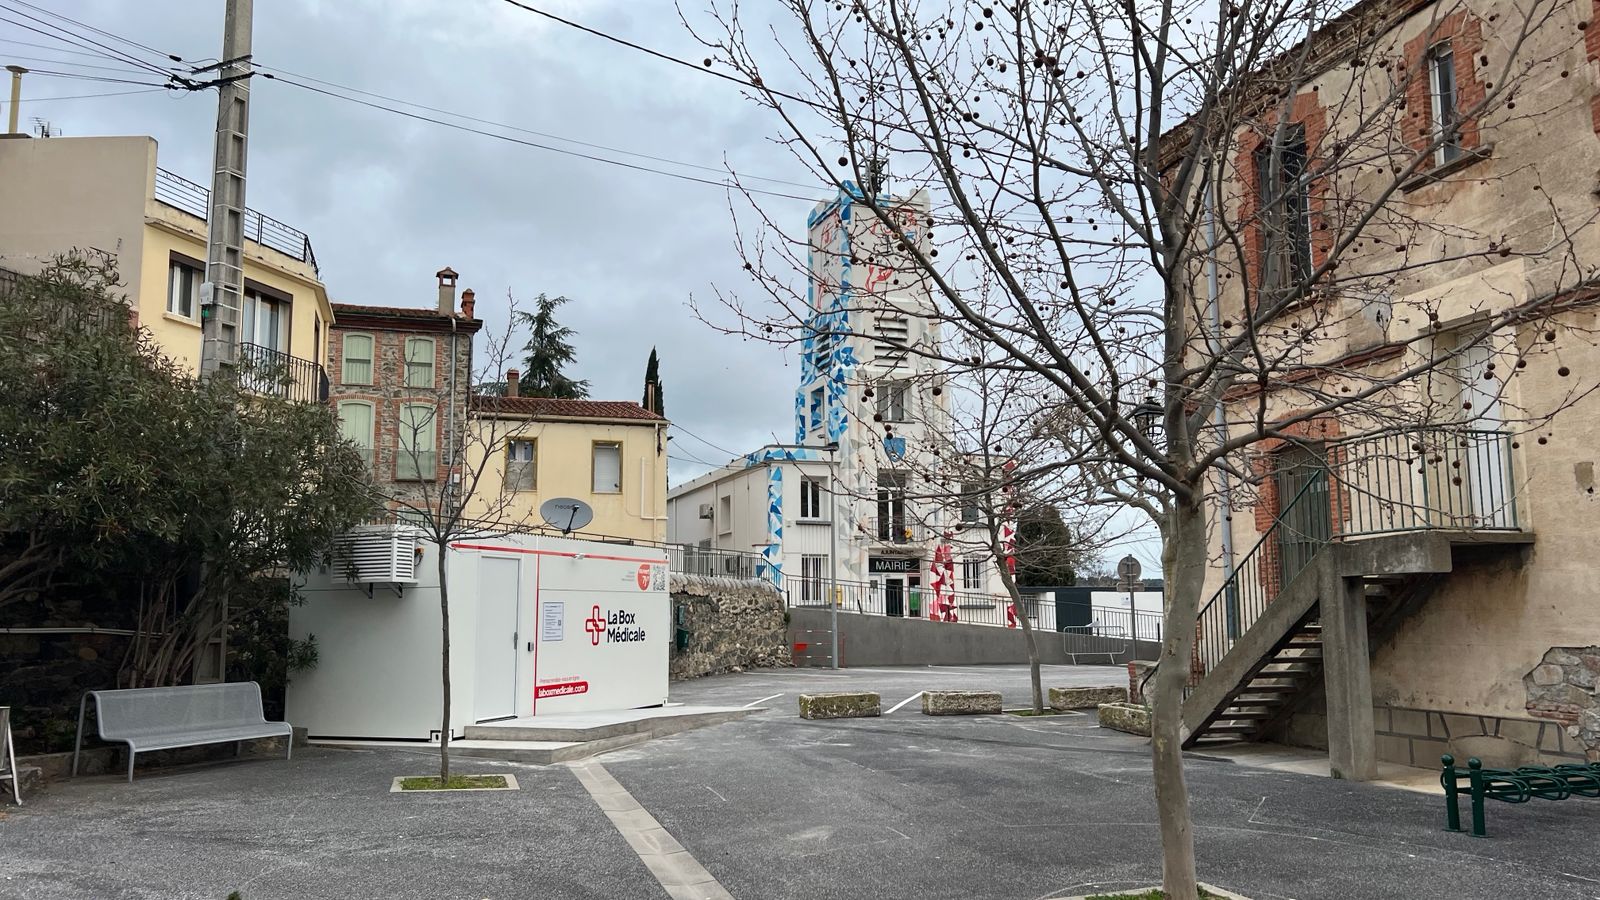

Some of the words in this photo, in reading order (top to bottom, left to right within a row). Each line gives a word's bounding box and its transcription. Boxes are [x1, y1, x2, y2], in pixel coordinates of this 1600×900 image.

[875, 561, 911, 570] MAIRIE
[607, 610, 617, 625] La
[619, 610, 635, 625] Box
[607, 626, 645, 643] Médicale
